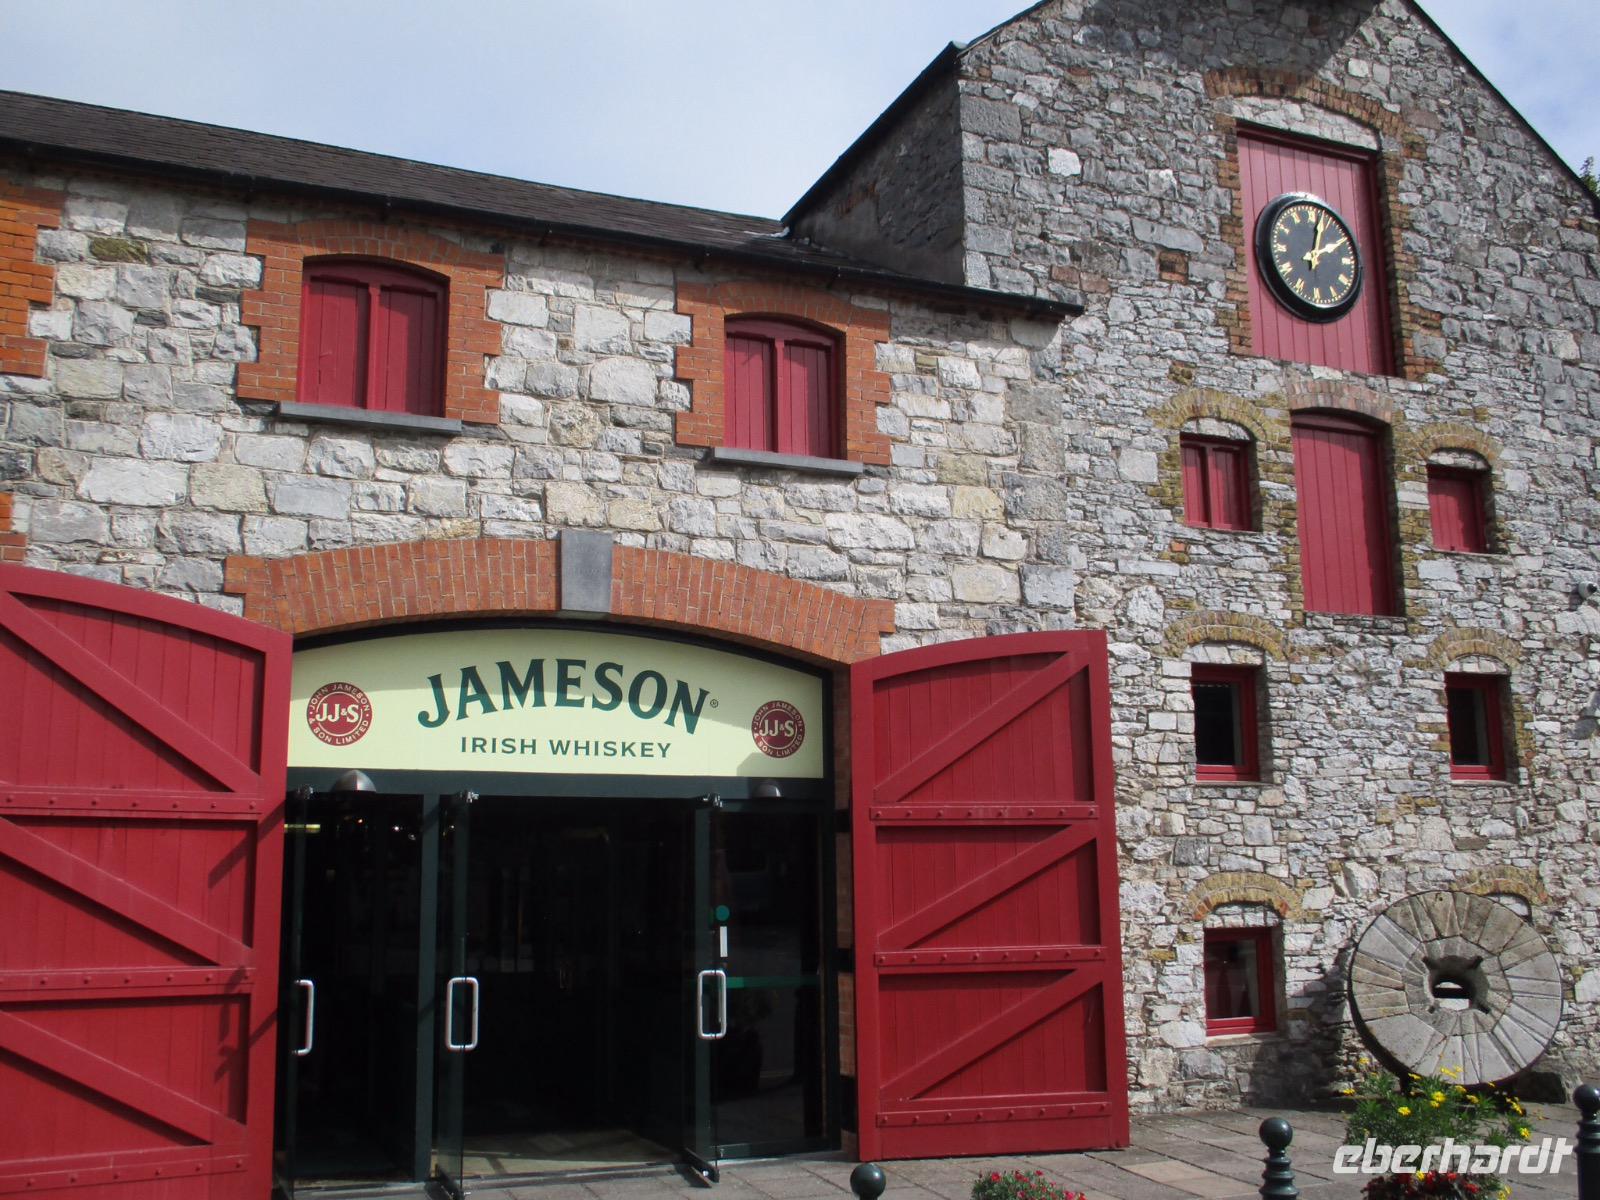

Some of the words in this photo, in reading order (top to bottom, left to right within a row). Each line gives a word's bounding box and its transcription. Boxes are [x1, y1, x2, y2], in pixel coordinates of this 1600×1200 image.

[309, 687, 329, 710] JOHN
[332, 684, 370, 711] JAMESON
[417, 658, 711, 734] JAMESON
[315, 703, 359, 723] JJ&S
[313, 726, 332, 743] SON
[335, 720, 369, 745] LIMITED
[759, 719, 795, 737] JJ&S
[461, 736, 537, 755] IRISH
[549, 739, 672, 758] WHISKEY
